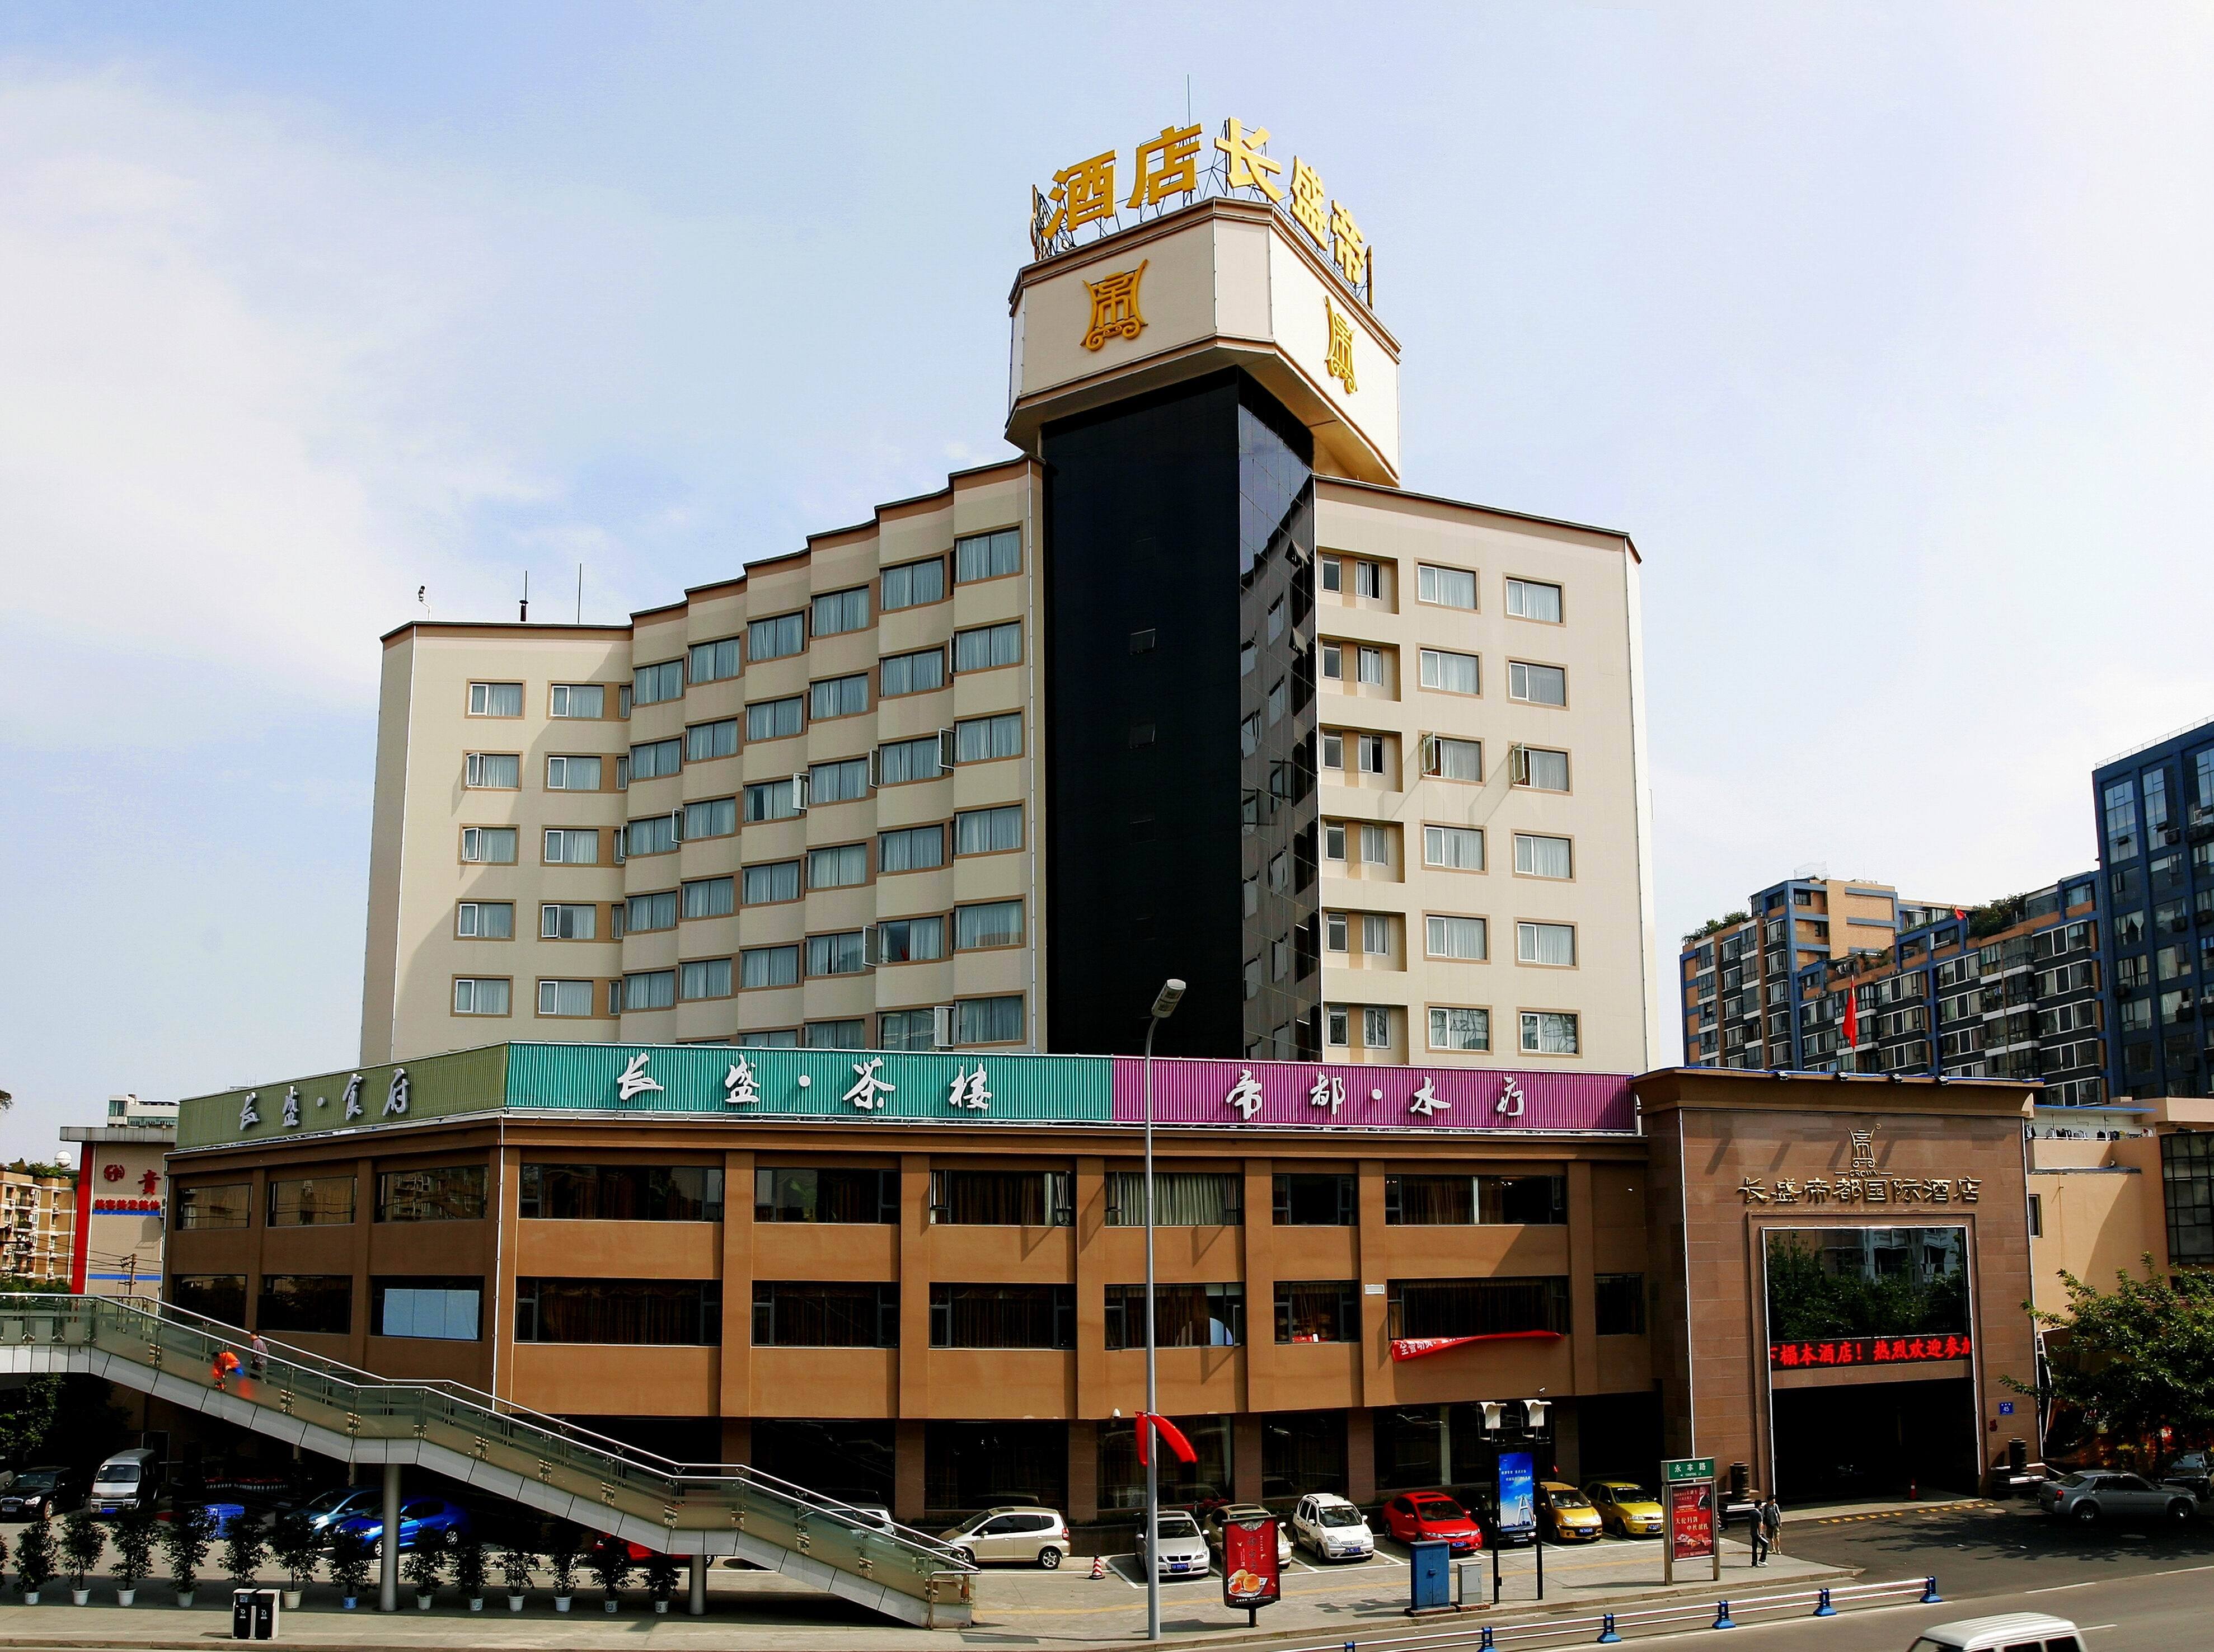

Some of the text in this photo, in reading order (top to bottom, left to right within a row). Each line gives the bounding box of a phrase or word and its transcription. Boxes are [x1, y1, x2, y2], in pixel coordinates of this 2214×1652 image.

[1736, 1176, 1982, 1203] 长盛帝都国际酒店
[1674, 1462, 1706, 1473] 永丰路
